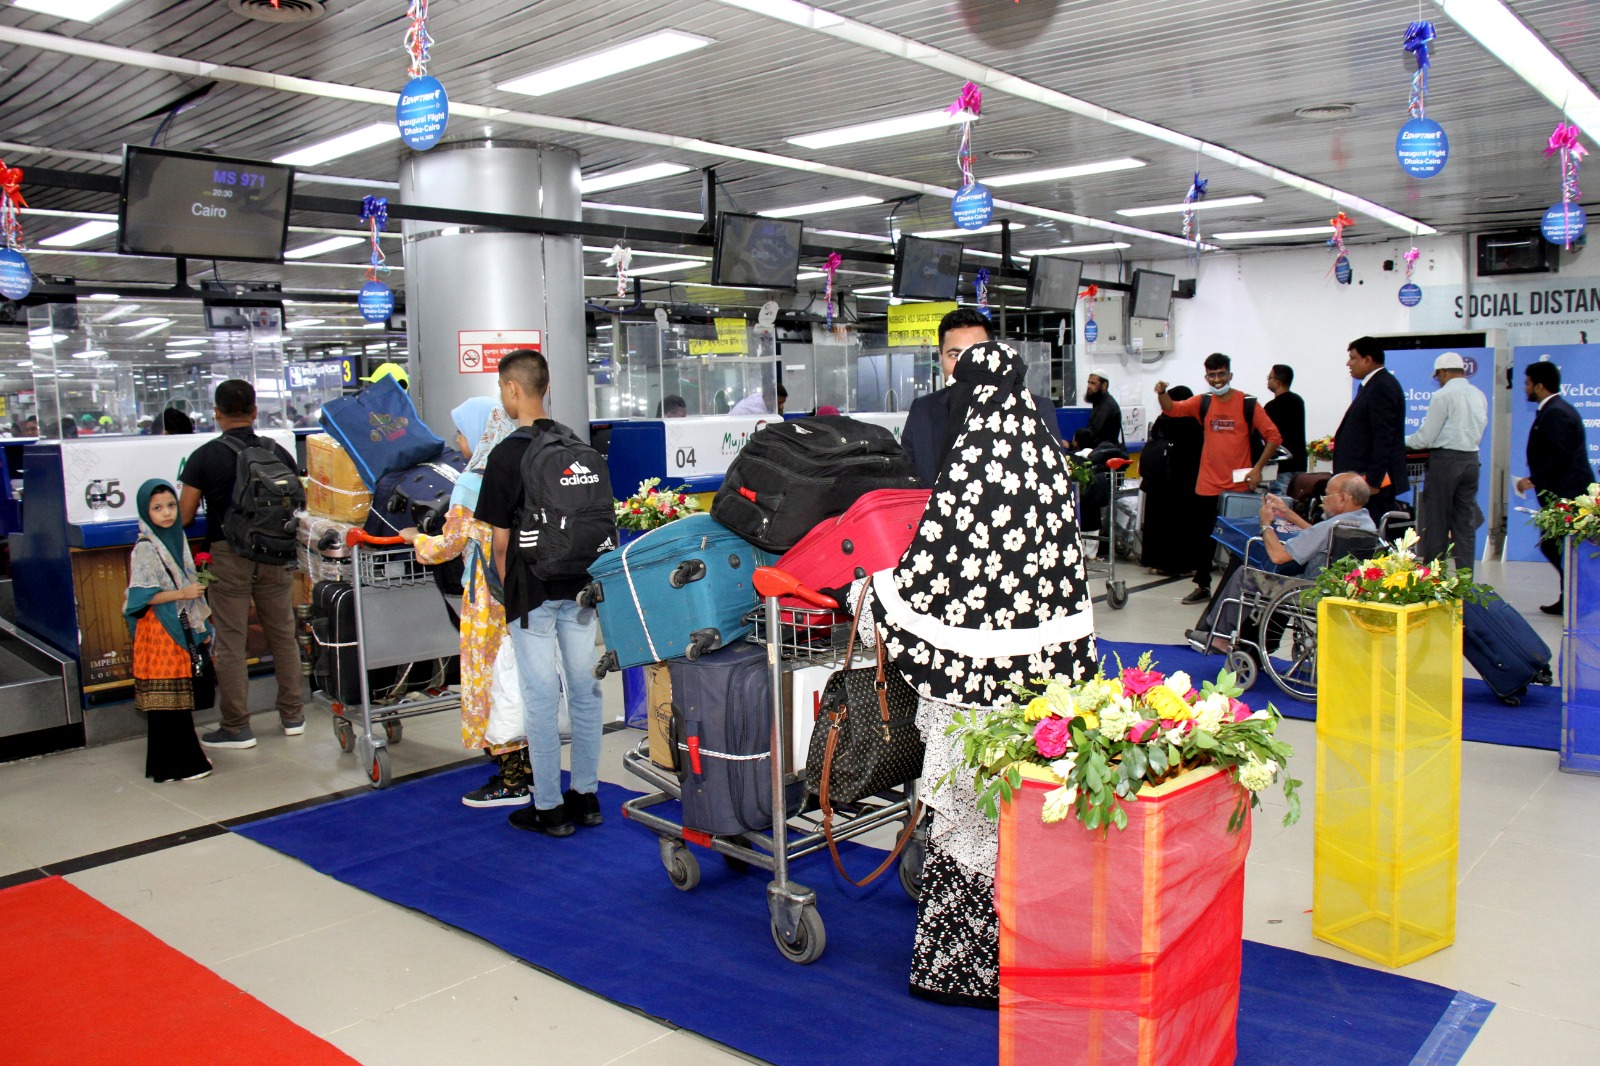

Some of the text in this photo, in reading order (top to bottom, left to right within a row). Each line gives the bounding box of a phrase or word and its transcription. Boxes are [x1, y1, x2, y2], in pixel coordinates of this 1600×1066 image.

[399, 112, 445, 127] Inaugural Flight
[405, 124, 440, 135] Dhaka-Cairo
[213, 170, 265, 188] MS 971
[212, 188, 233, 198] 20:30
[191, 202, 227, 218] Cairo
[958, 214, 988, 222] Dhaka-Cairo
[1454, 287, 1600, 318] SOCIAL DISTAN
[342, 360, 352, 382] 3
[1404, 388, 1432, 400] elco
[1560, 384, 1600, 396] Welco
[1405, 416, 1419, 426] ing
[676, 448, 696, 468] 04
[560, 474, 600, 486] adidas
[90, 656, 130, 668] IMPERIAL
[91, 670, 133, 680] LOUNG
